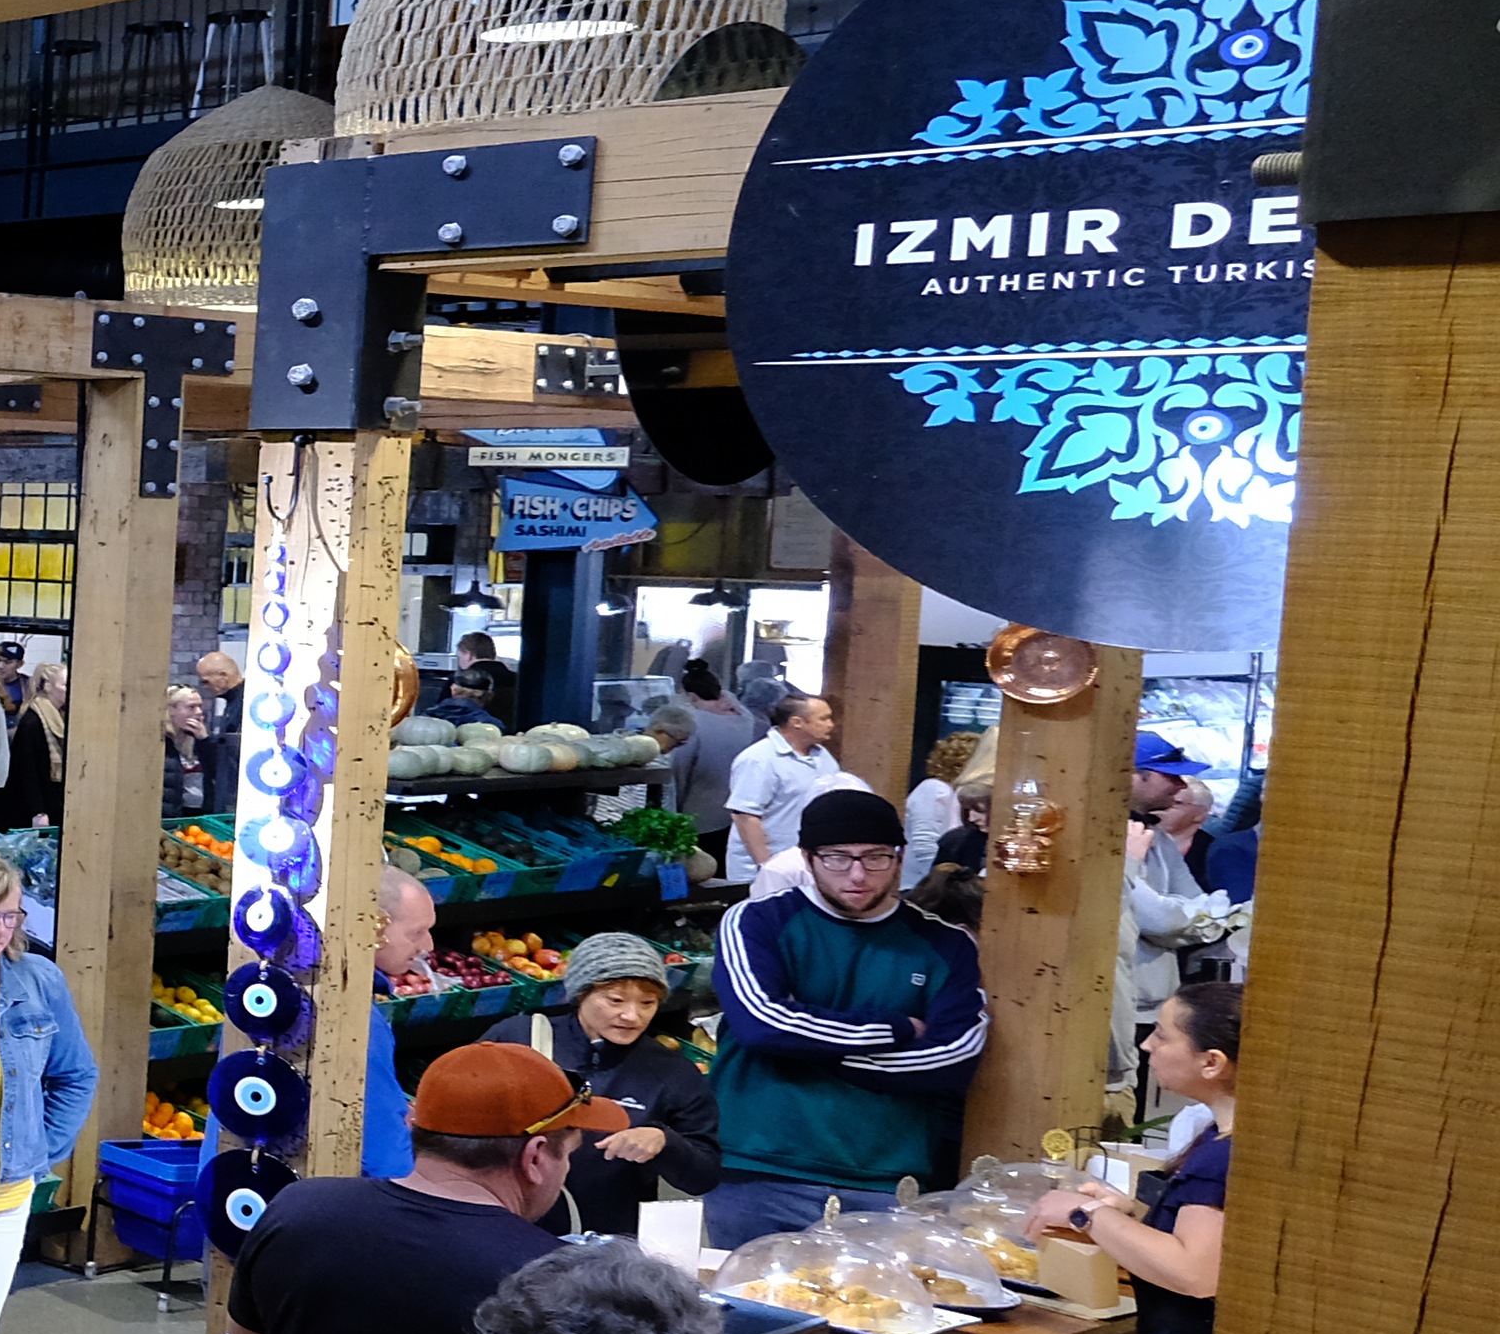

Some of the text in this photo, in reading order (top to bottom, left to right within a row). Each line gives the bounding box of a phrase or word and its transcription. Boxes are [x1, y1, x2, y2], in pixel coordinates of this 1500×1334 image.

[854, 208, 1121, 267] IZMIR
[920, 267, 1146, 296] AUTHENTIC
[512, 494, 561, 520] FISH
[572, 495, 639, 522] CHIPS
[514, 523, 587, 538] SASHIMI
